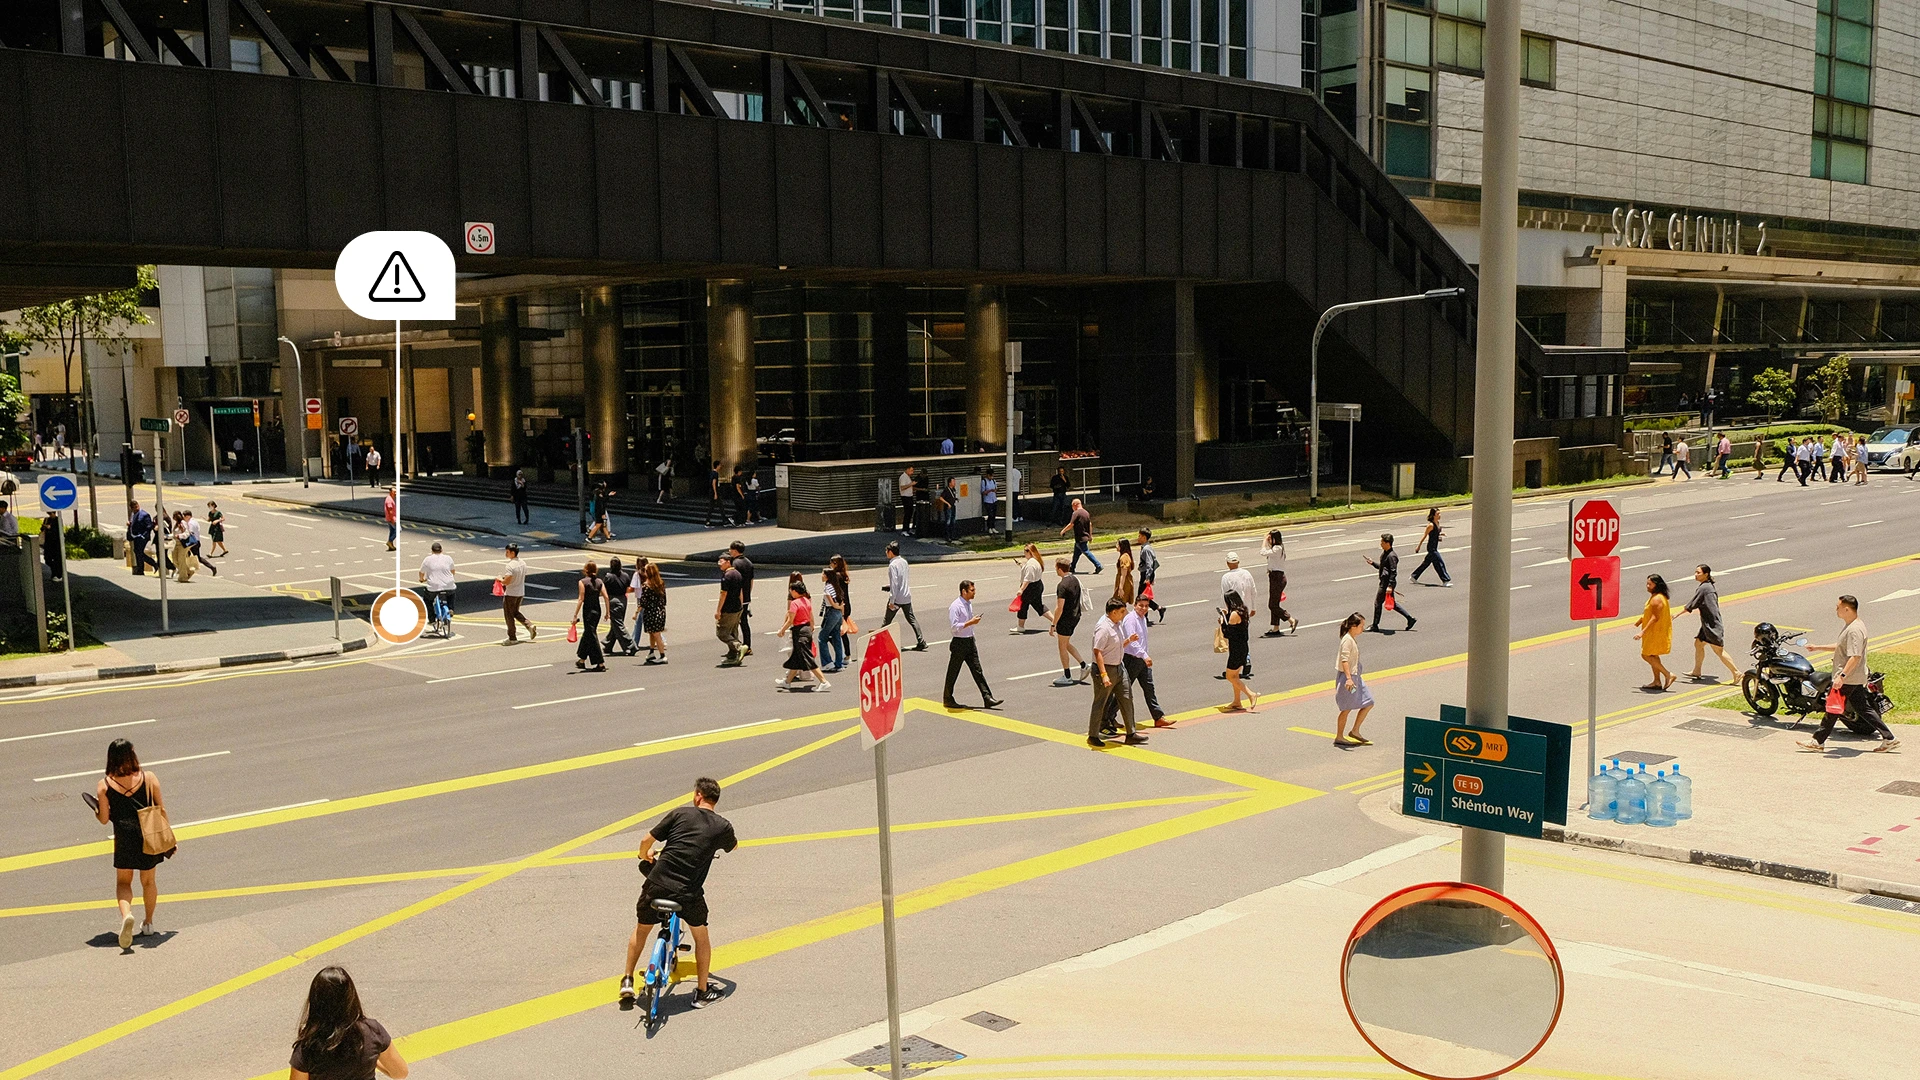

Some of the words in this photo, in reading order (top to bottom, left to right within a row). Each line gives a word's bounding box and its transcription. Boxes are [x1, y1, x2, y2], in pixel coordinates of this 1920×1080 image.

[1612, 206, 1654, 249] SGX
[471, 234, 489, 243] 4.5m
[1575, 518, 1618, 542] STOP
[861, 657, 900, 713] STOP
[1485, 742, 1504, 752] MRT
[1412, 783, 1433, 796] 70m
[1457, 779, 1467, 788] TE
[1469, 780, 1479, 790] 19
[1451, 796, 1503, 816] Shenton
[1507, 806, 1534, 823] Way
